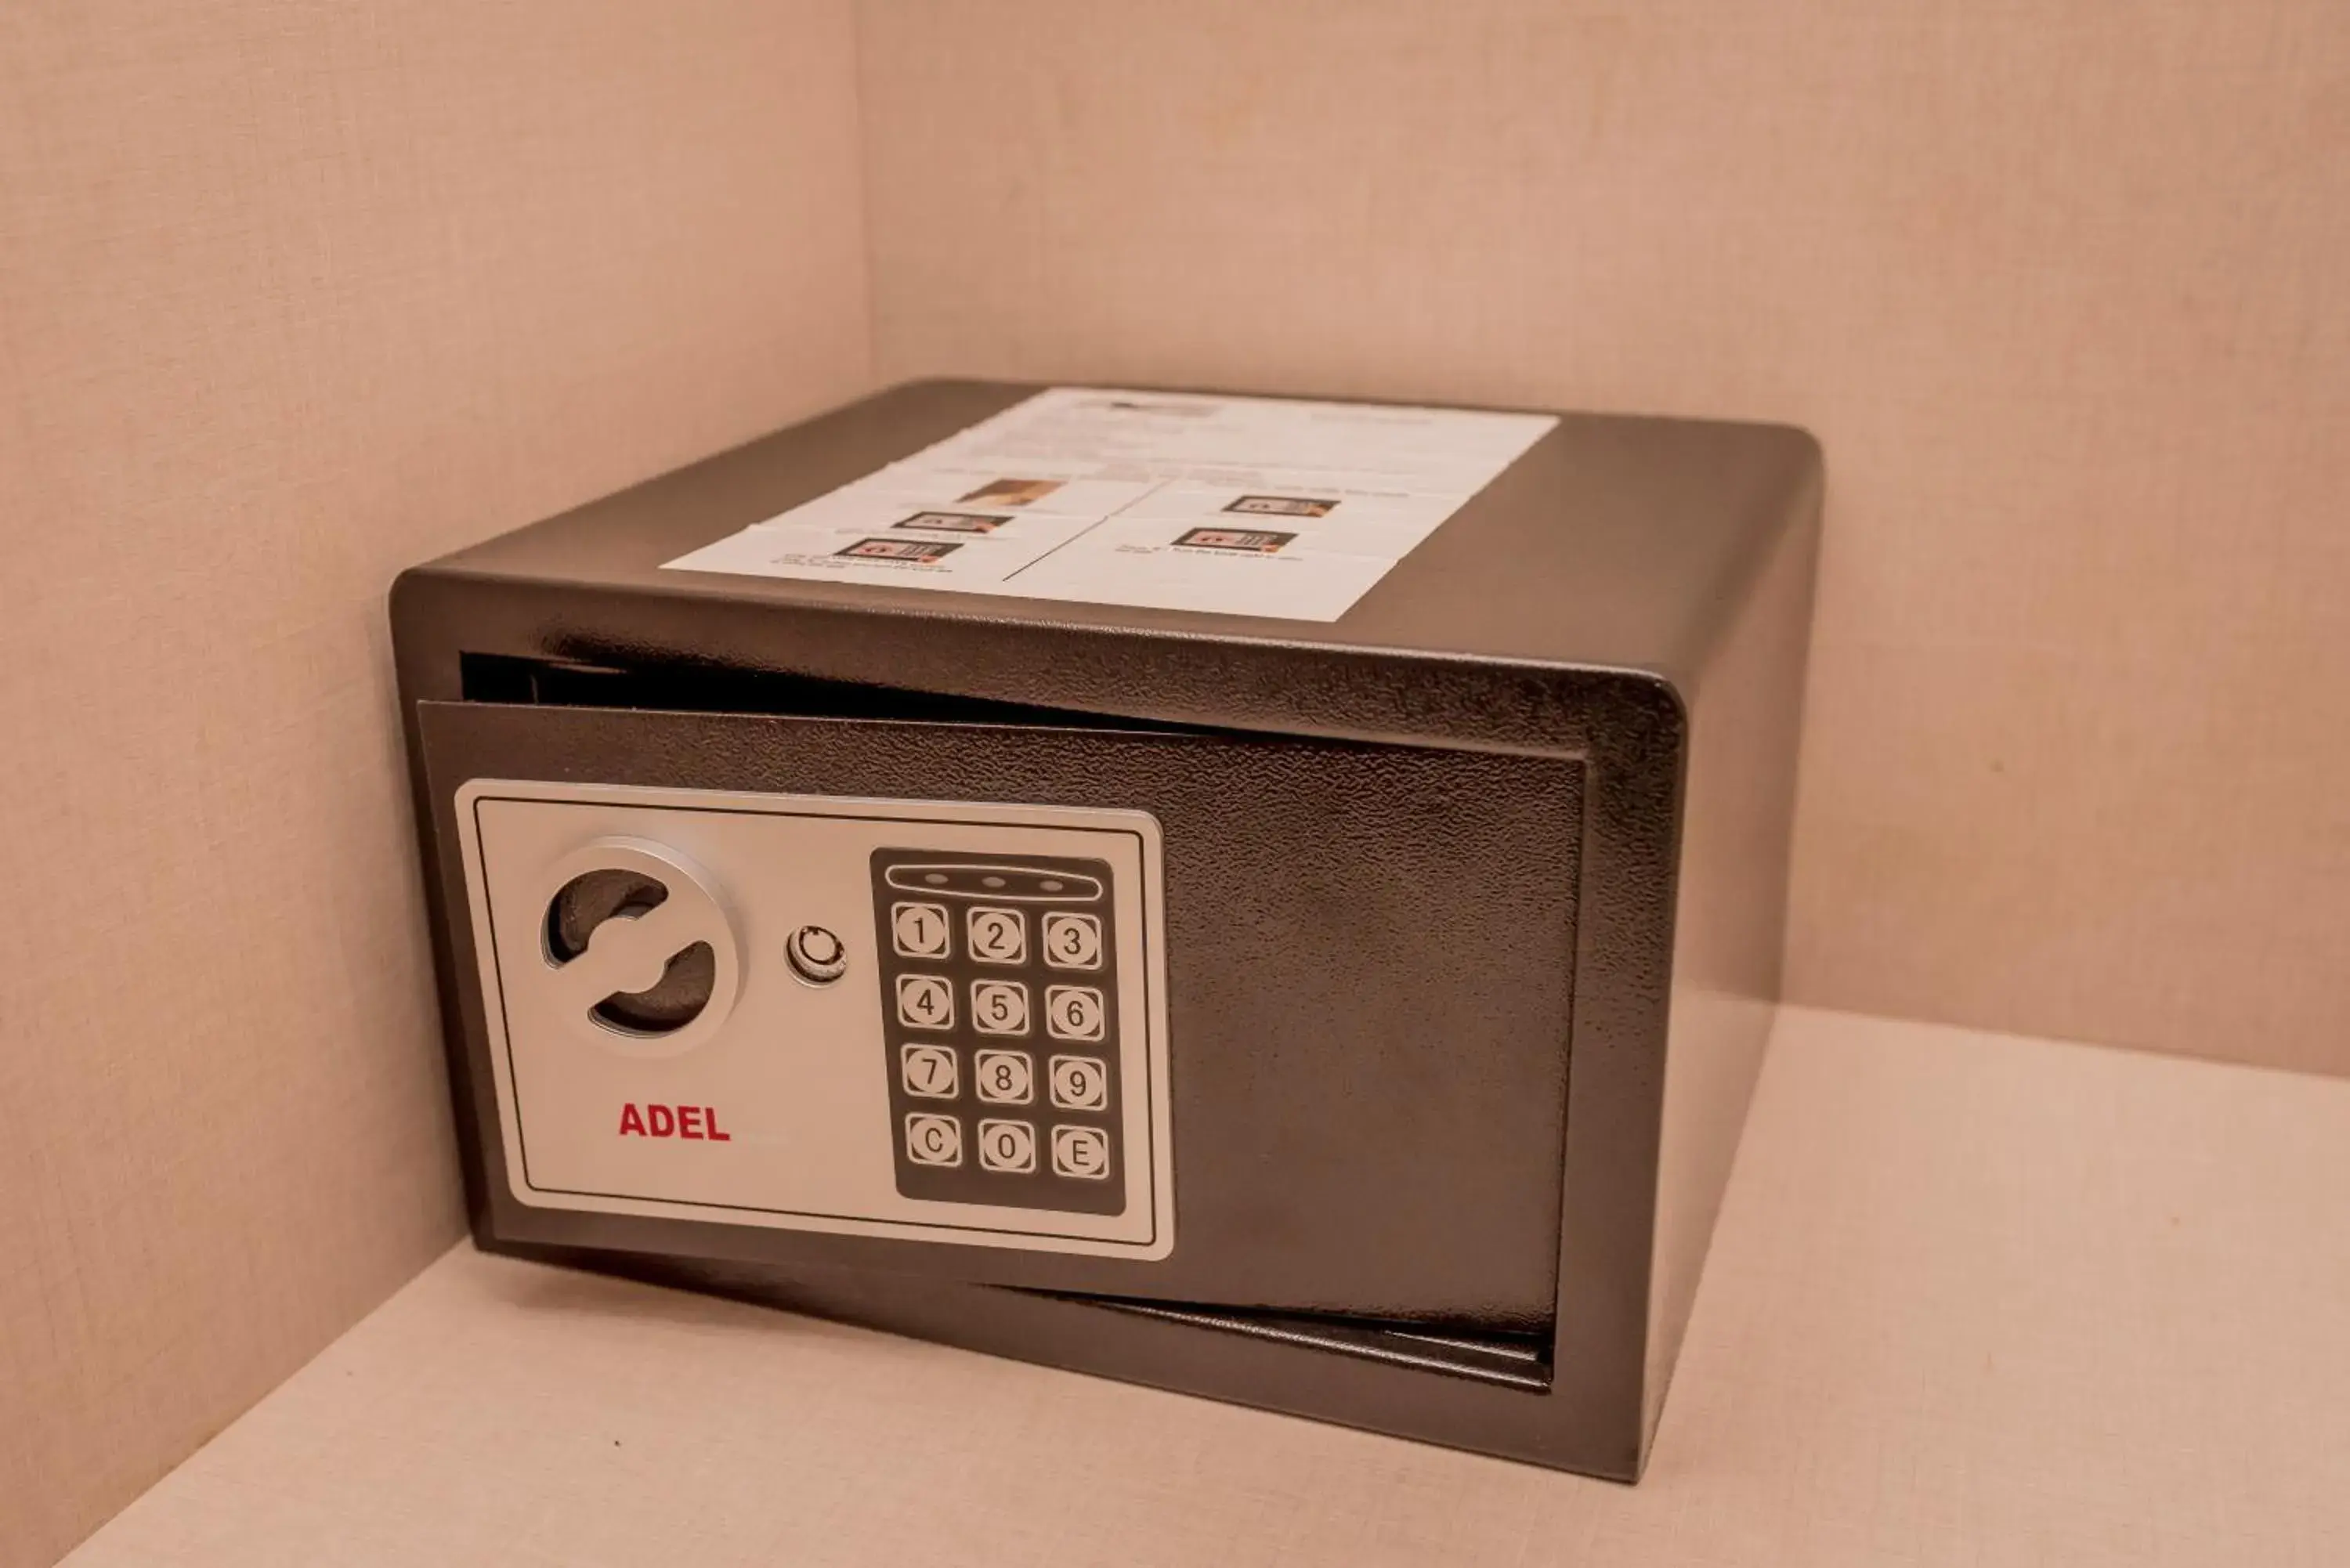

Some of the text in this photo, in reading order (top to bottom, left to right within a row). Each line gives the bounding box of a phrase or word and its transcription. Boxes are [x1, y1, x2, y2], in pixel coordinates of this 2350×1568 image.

[915, 918, 1081, 954] 1 2 3
[917, 989, 1083, 1026] 4 5 6
[923, 1059, 1086, 1097] 7 8 9
[620, 1103, 731, 1141] ADEL
[926, 1128, 1089, 1165] C 0 E
